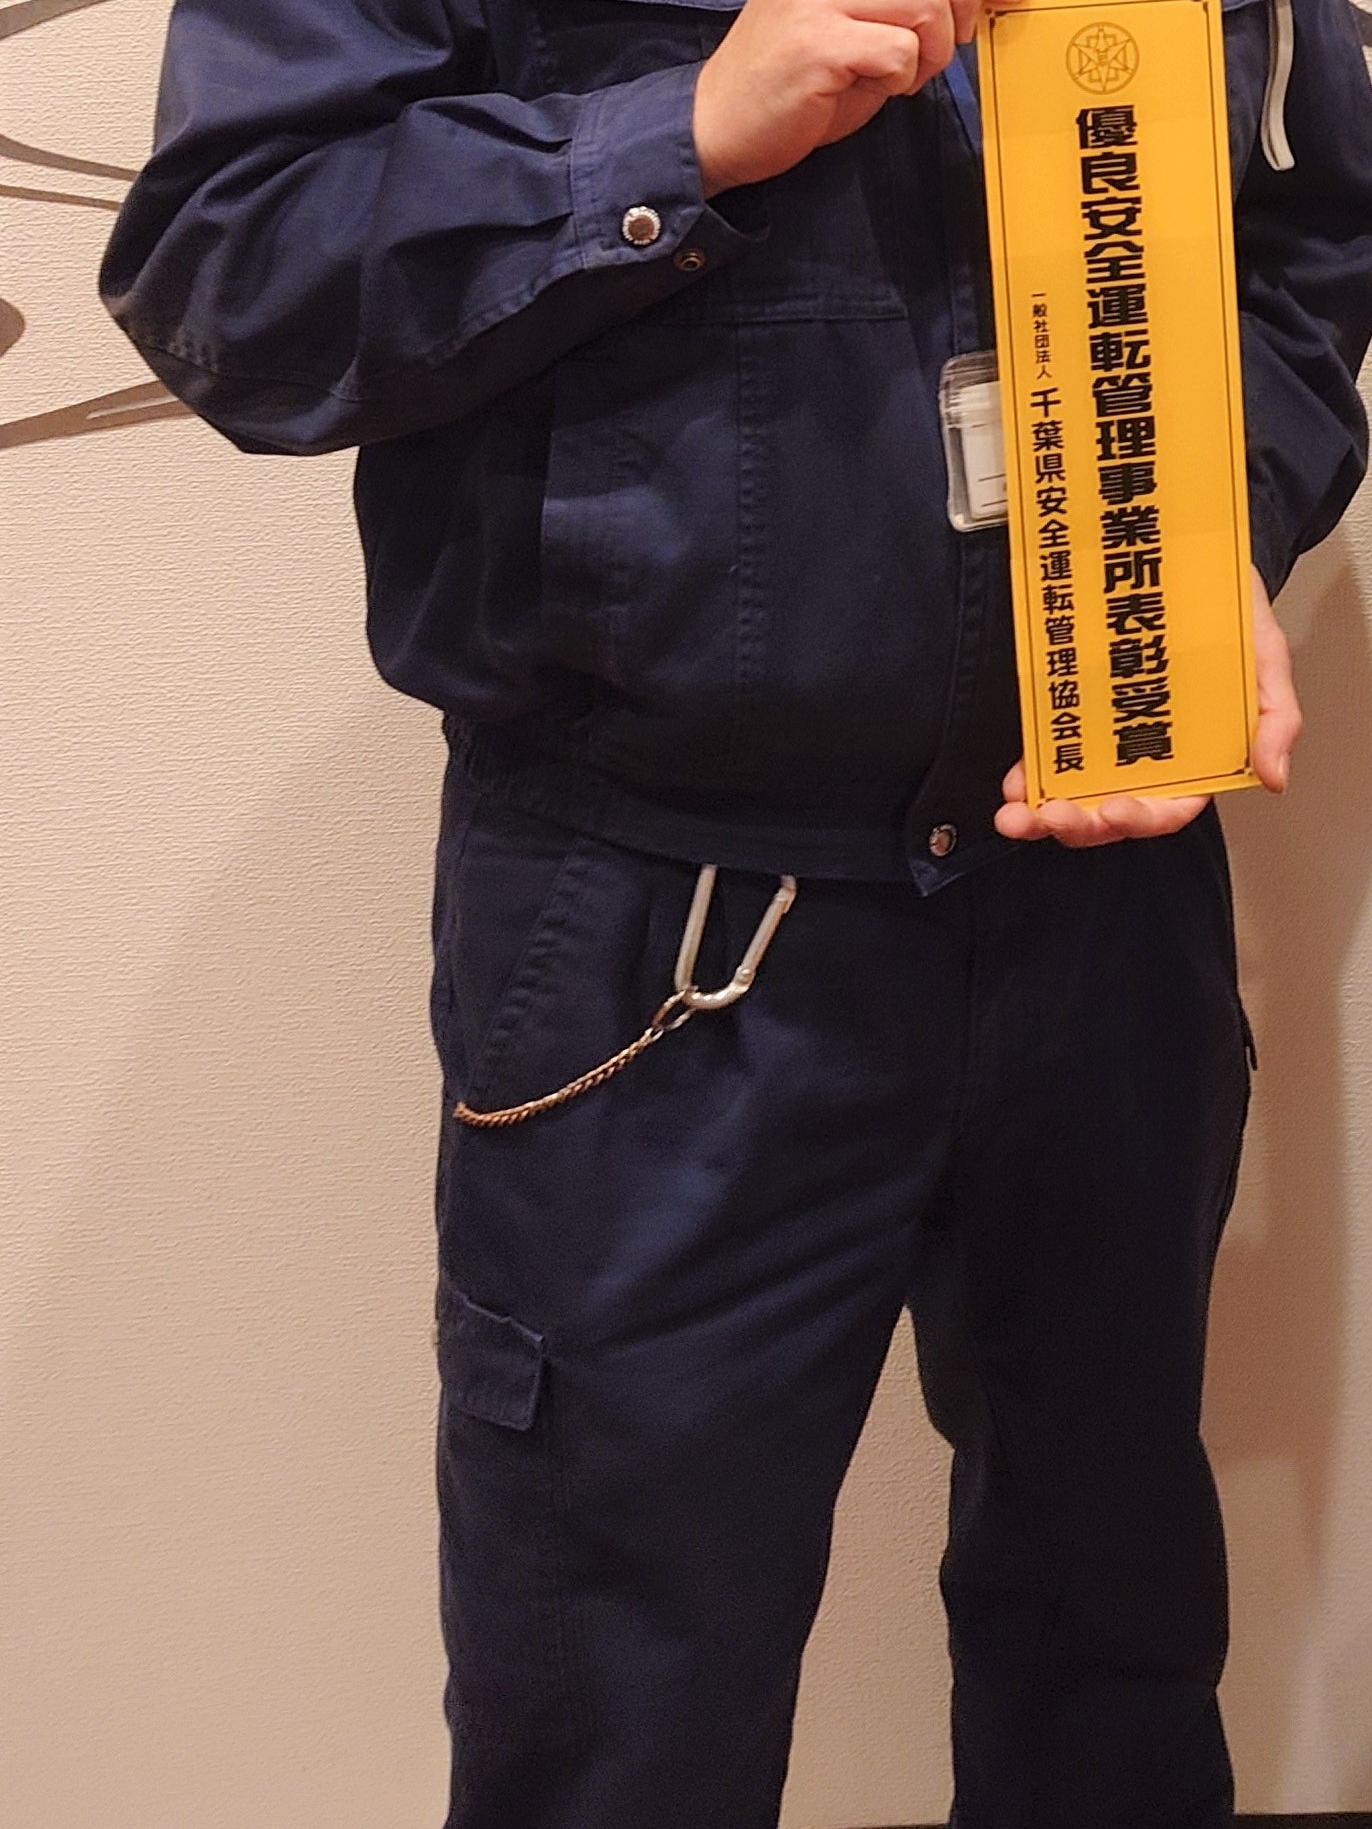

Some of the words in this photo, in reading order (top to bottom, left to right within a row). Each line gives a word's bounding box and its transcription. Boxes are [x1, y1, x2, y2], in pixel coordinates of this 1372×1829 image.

[1031, 292, 1052, 380] 一般社団法人
[1076, 104, 1174, 767] 優良安全運転管理事業所表彰受賞
[1030, 386, 1084, 775] 千葉県安全運転管理協会長
